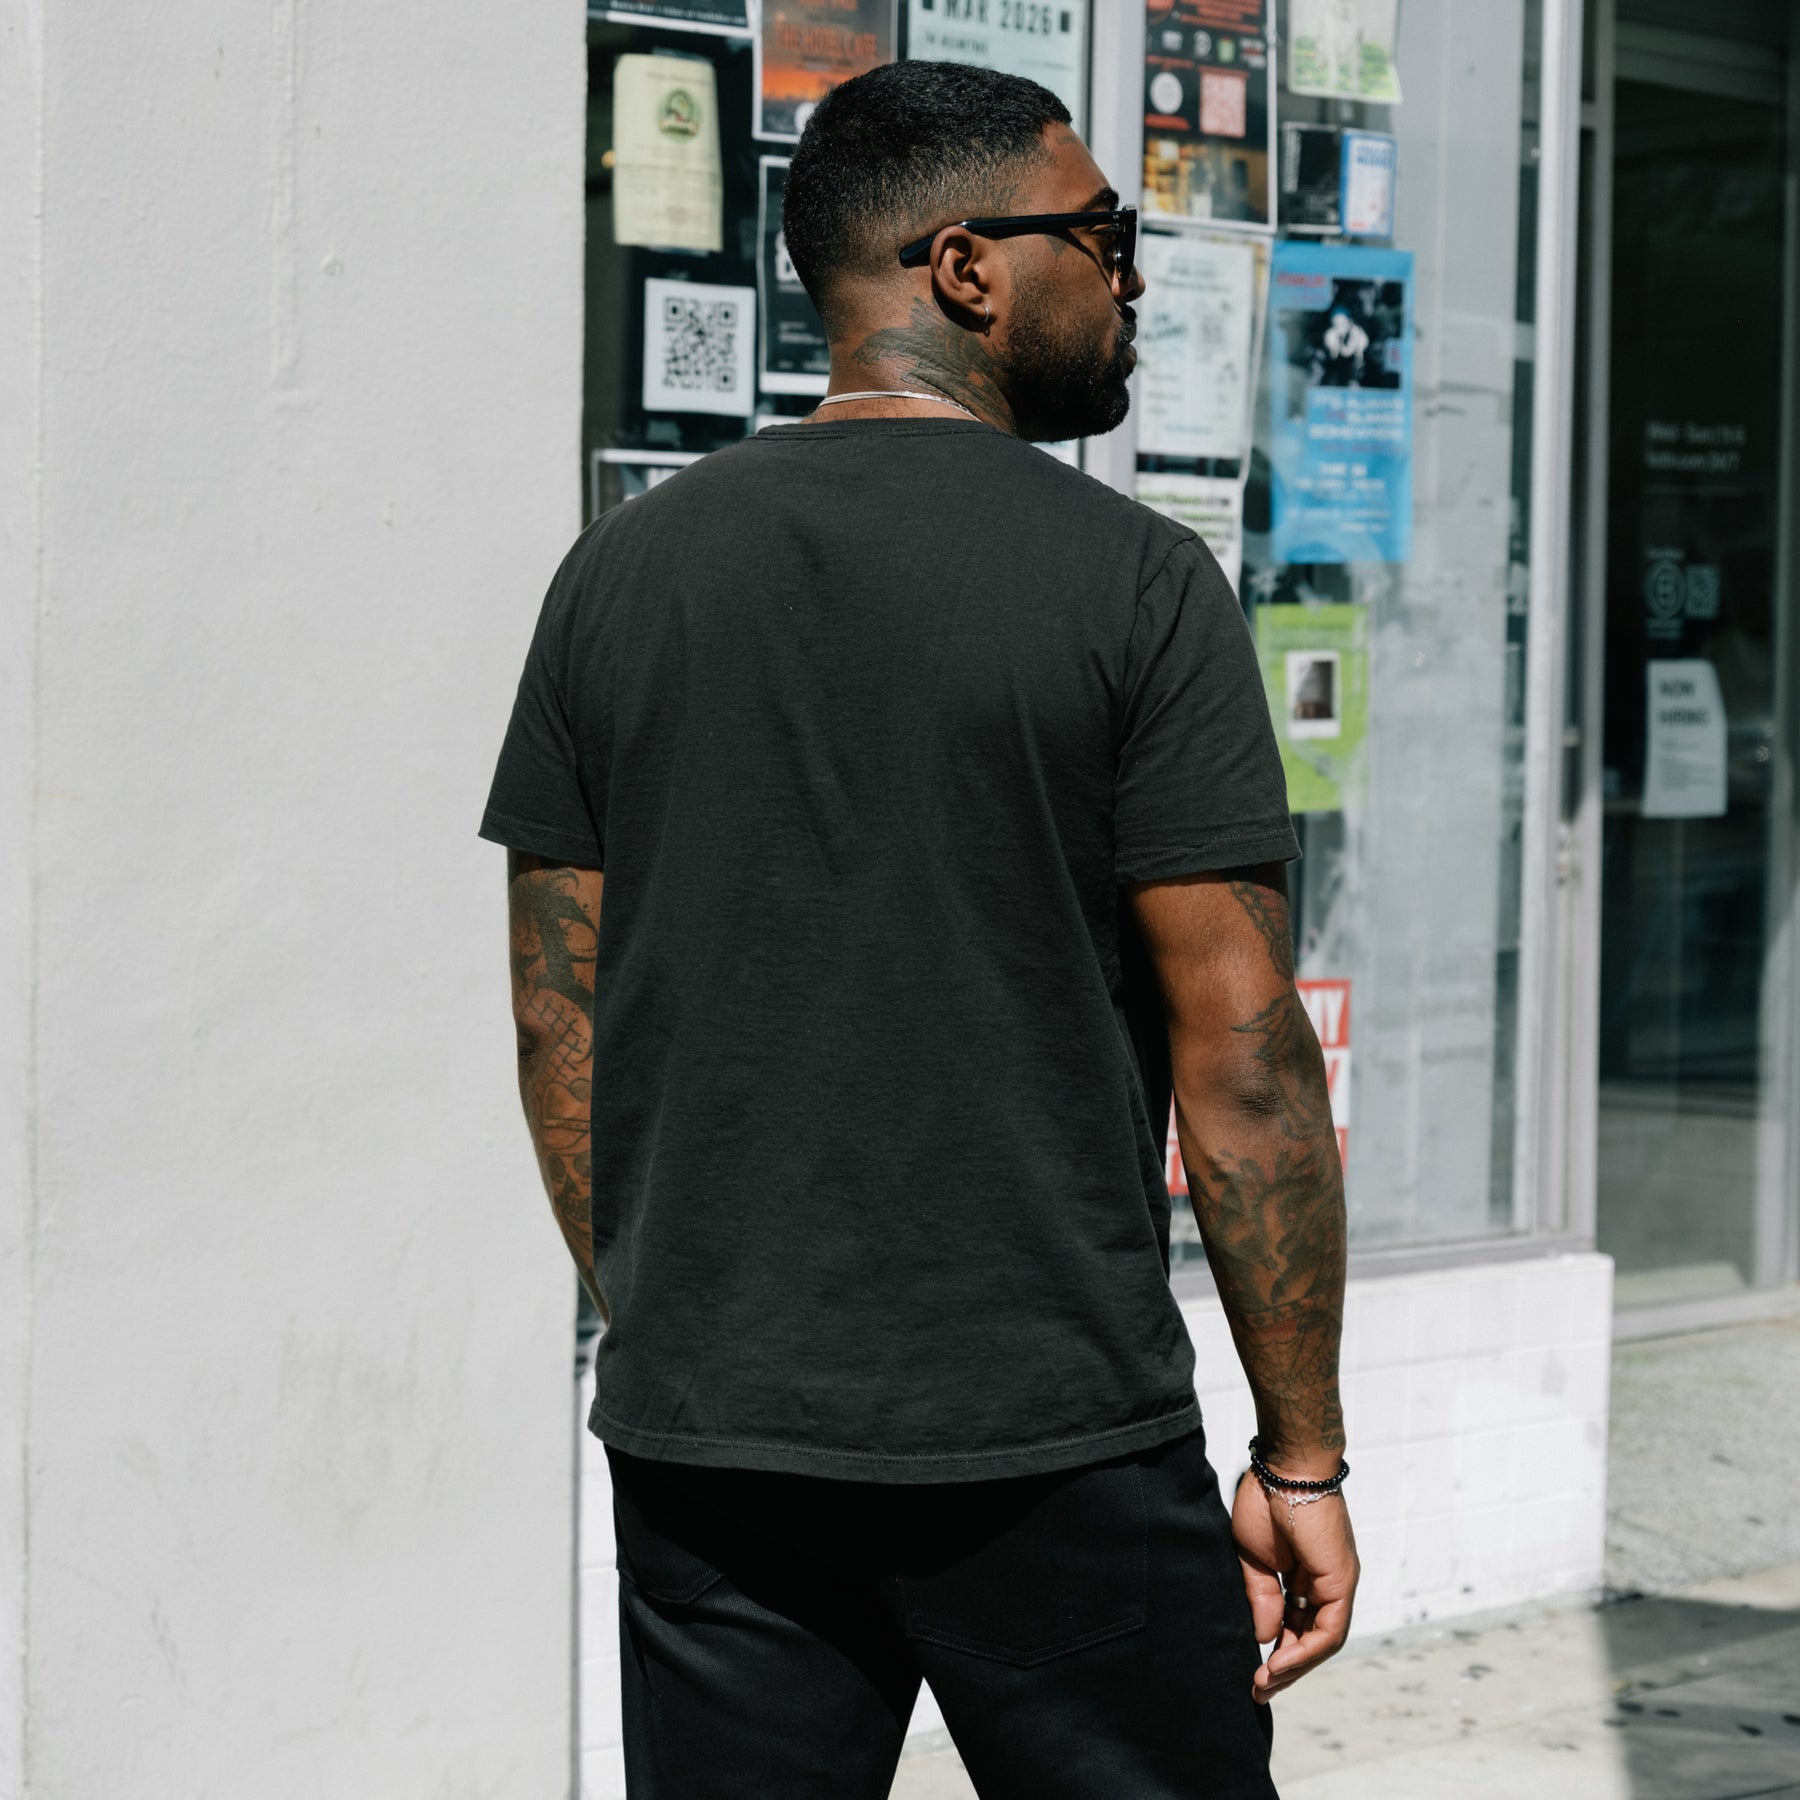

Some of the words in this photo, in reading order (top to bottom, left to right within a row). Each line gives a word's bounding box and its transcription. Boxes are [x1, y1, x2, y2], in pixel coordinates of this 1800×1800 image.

[999, 0, 1051, 34] 2026
[1660, 680, 1696, 698] NOW
[1660, 707, 1711, 728] HIRING
